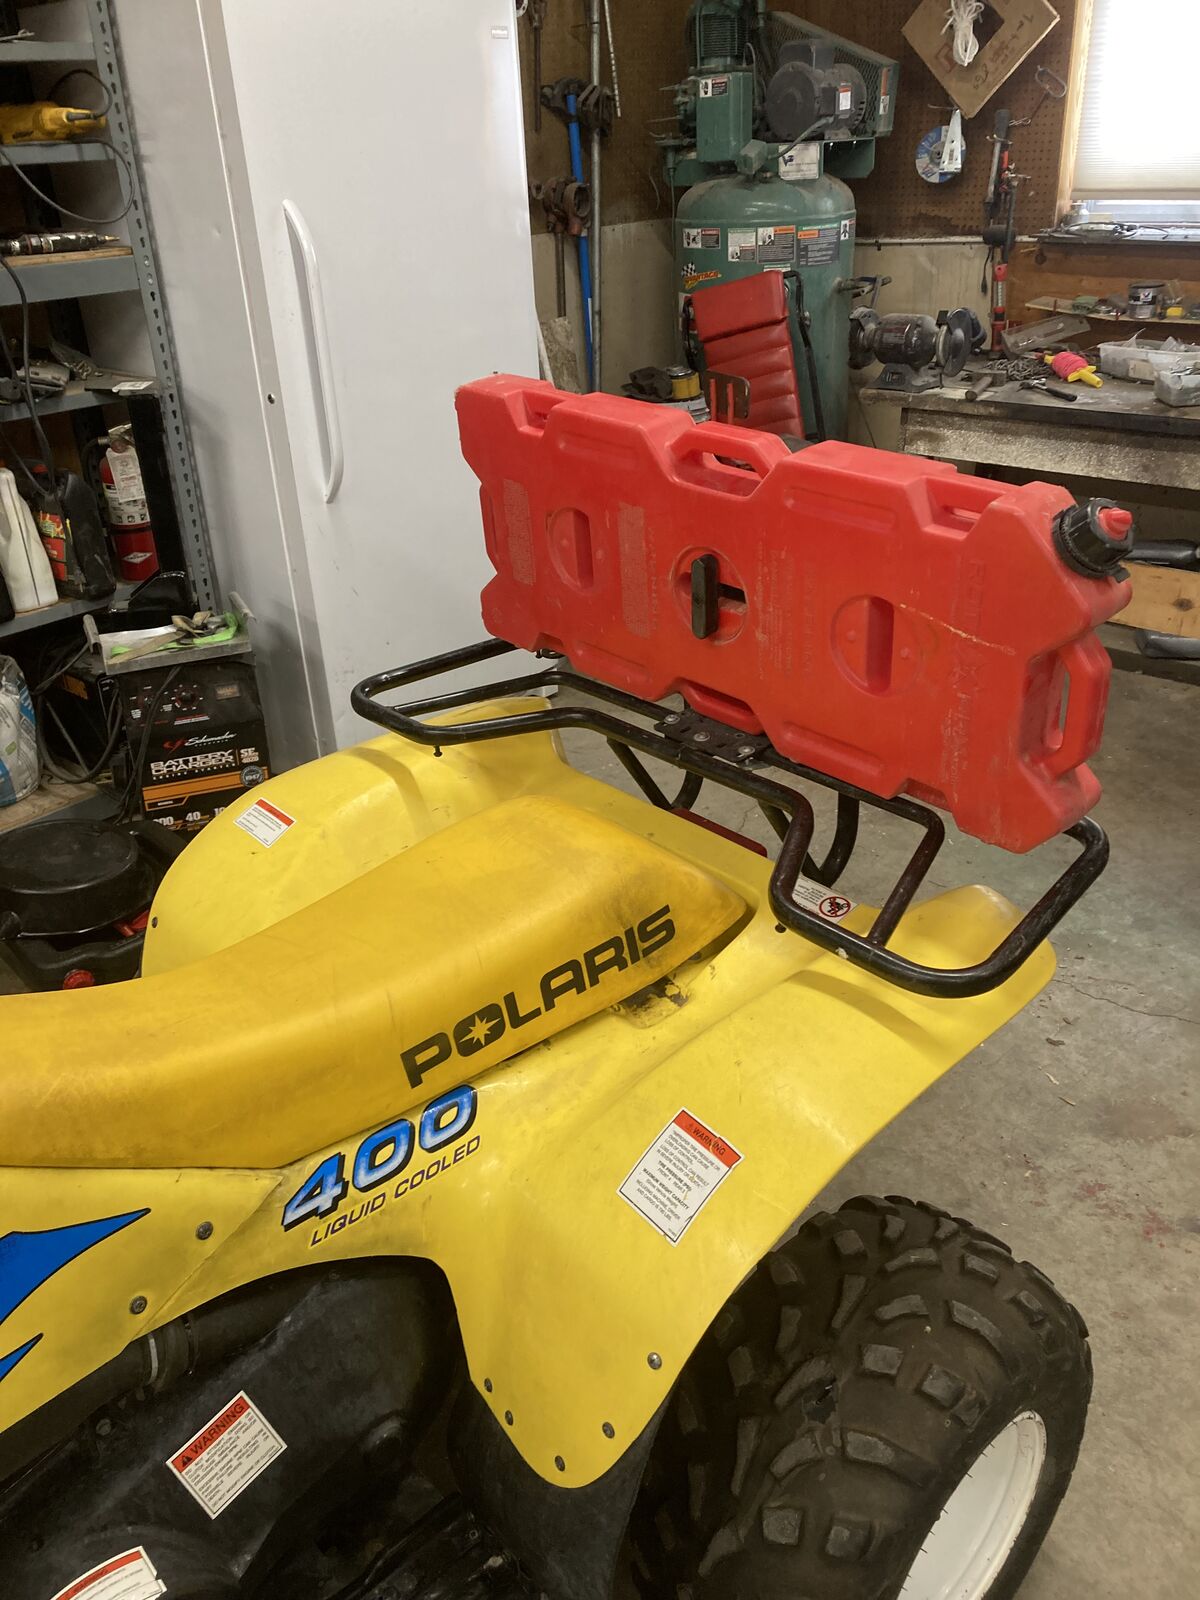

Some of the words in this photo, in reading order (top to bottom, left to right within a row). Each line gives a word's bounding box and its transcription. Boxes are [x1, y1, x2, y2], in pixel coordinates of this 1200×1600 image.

[150, 750, 233, 770] BATTERY
[151, 755, 234, 775] CHARGER
[185, 811, 201, 822] 40
[400, 904, 676, 1089] POLARIS
[281, 1084, 478, 1232] 400
[692, 1127, 726, 1156] WARNING
[310, 1192, 386, 1247] LIQUID
[394, 1135, 481, 1199] COOLED
[190, 1402, 245, 1454] WARNING
